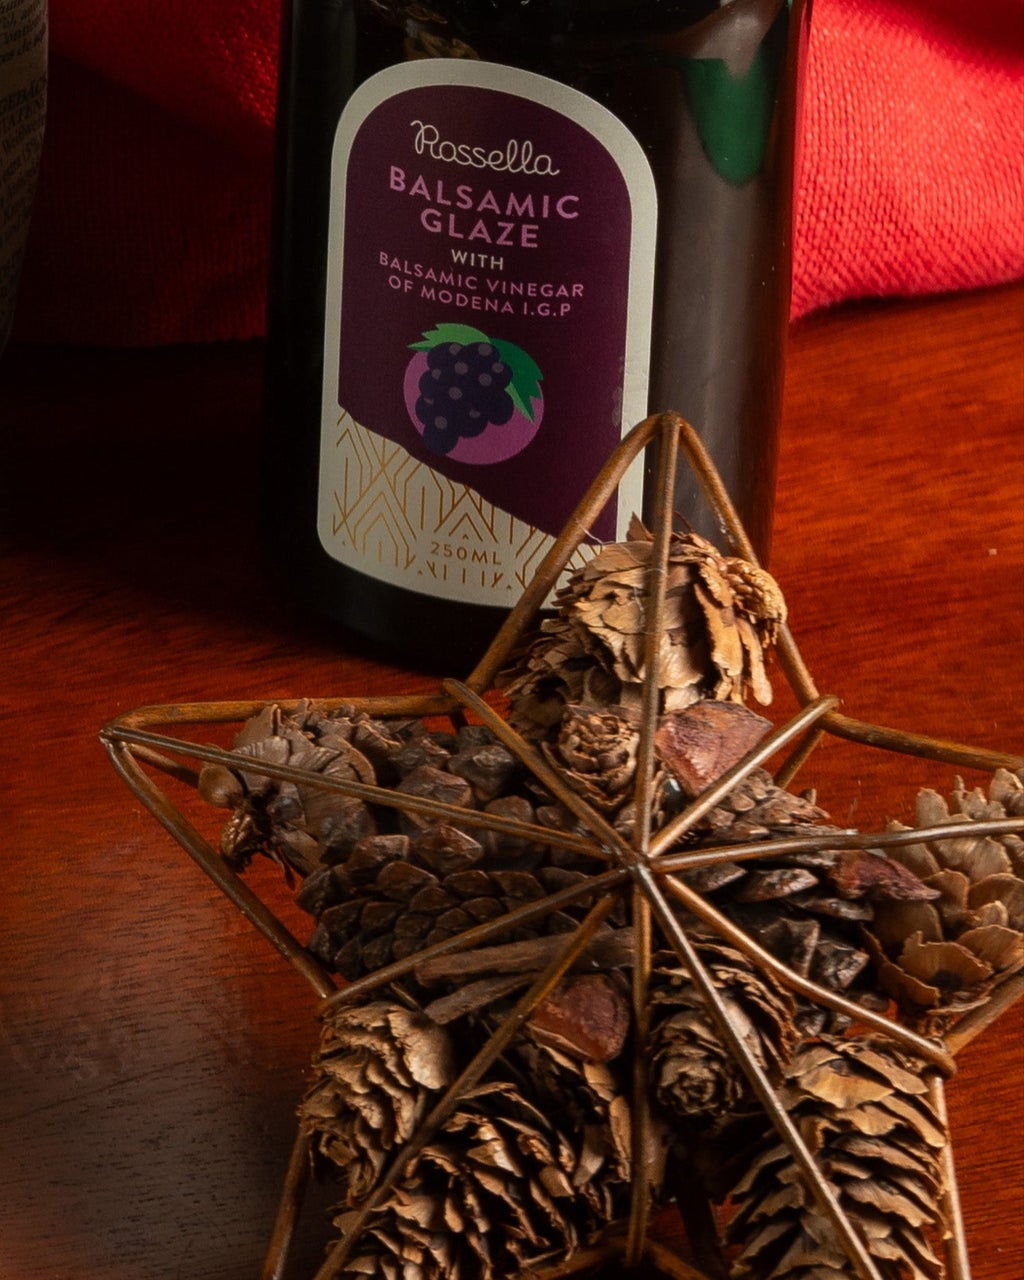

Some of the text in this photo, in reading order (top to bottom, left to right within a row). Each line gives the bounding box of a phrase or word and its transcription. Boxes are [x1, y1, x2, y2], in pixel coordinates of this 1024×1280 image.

[409, 120, 560, 176] Rossella
[388, 165, 580, 220] BALSAMIC
[419, 207, 540, 249] GLAZE
[379, 251, 585, 298] BALSAMIC VINEGAR
[451, 248, 504, 271] WITH
[387, 275, 414, 293] OF
[420, 285, 515, 315] MODENA
[429, 541, 503, 566] 250ML
